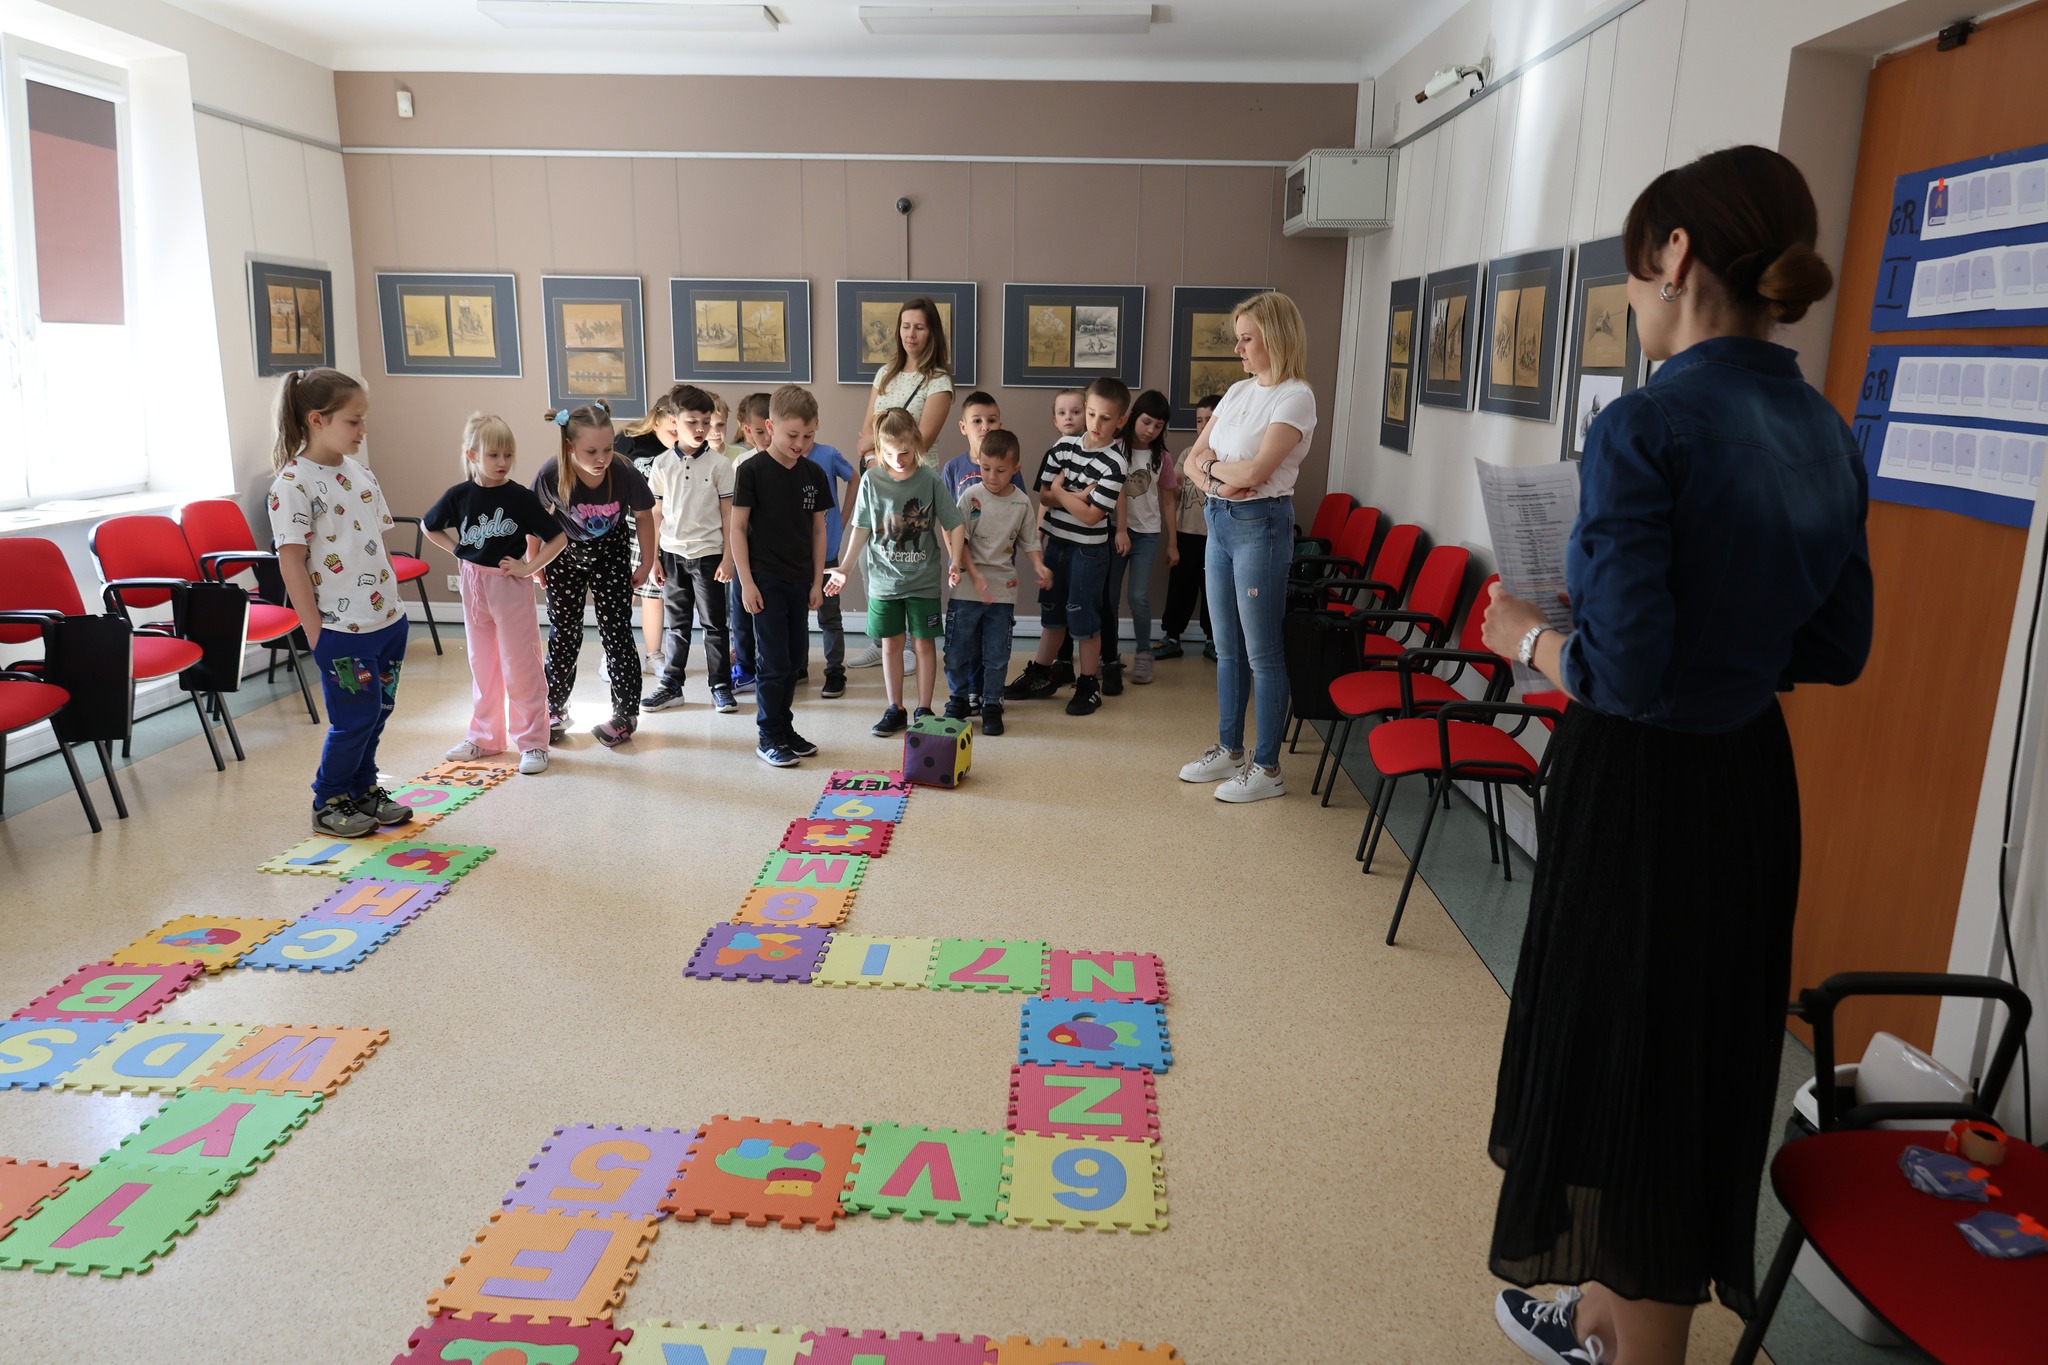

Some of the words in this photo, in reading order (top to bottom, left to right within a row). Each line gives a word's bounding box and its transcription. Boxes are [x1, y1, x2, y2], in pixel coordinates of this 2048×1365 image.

[831, 779, 911, 791] META
[331, 885, 422, 917] H
[759, 892, 819, 921] 8
[281, 928, 358, 960] C
[949, 948, 1007, 983] 7
[1071, 959, 1137, 993] N
[56, 974, 164, 1012] B
[0, 1028, 78, 1074] S
[112, 1033, 225, 1079] D
[1044, 1074, 1123, 1126] Z
[147, 1103, 257, 1157] Y
[547, 1139, 652, 1203] 5
[478, 1228, 615, 1301] F
